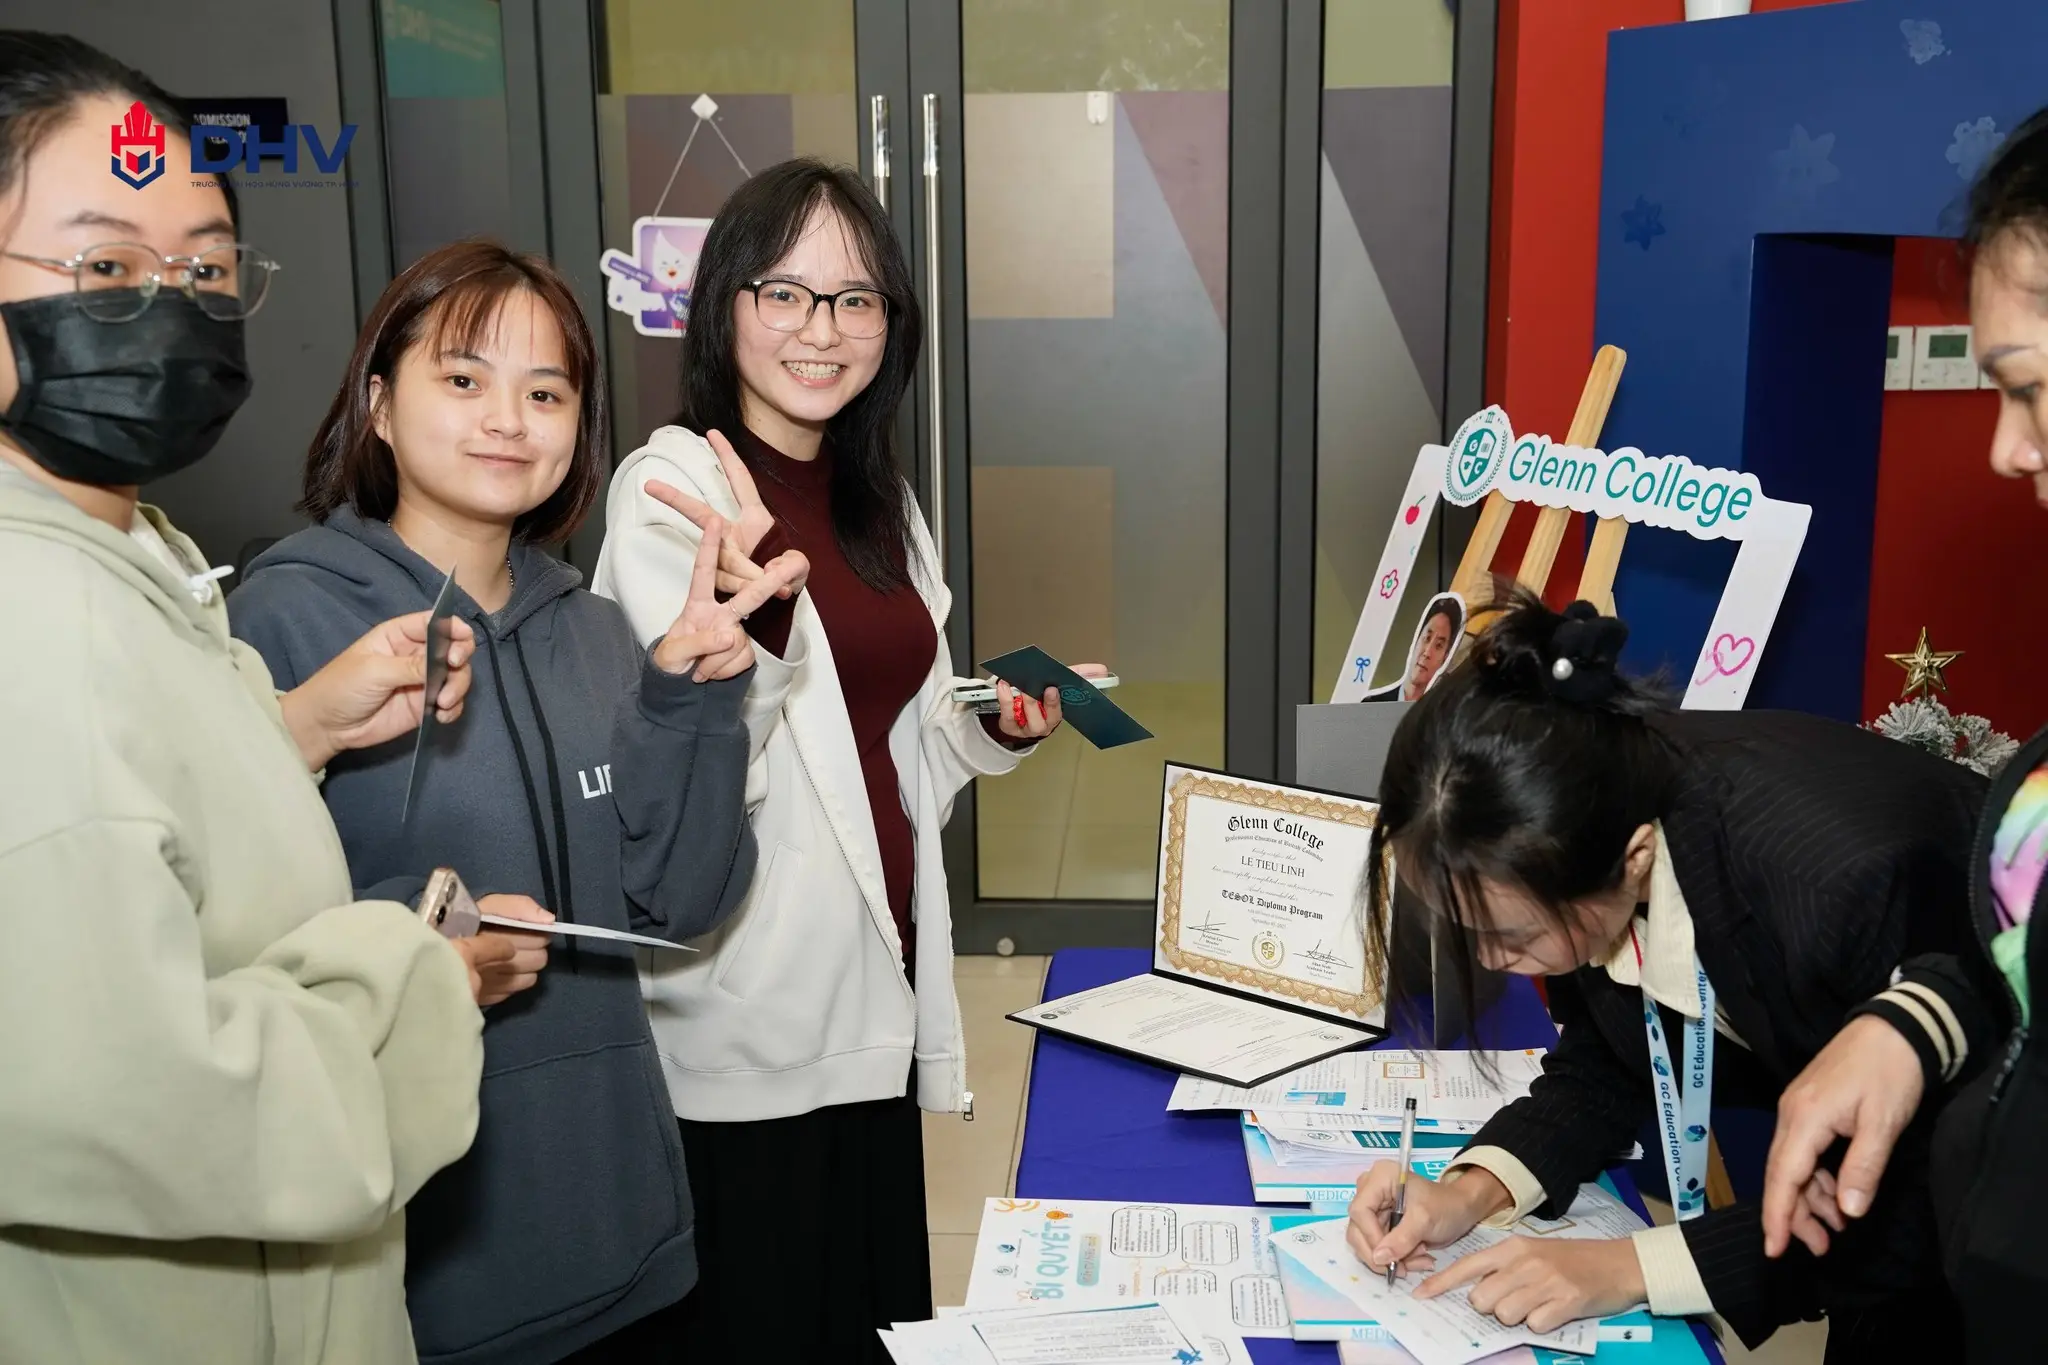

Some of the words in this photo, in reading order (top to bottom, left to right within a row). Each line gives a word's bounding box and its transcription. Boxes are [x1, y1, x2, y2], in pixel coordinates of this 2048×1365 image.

[1509, 442, 1597, 493] Glenn
[1605, 456, 1753, 528] College
[1227, 815, 1268, 831] Glenn
[1274, 817, 1324, 850] College
[1241, 856, 1254, 866] LE
[1256, 859, 1279, 872] TIEU
[1280, 864, 1305, 877] LINH
[1221, 889, 1255, 905] TESOL
[1257, 897, 1287, 912] Diploma
[1289, 905, 1324, 920] Program
[1660, 1081, 1671, 1100] GC
[1693, 1072, 1703, 1089] GC
[1663, 1101, 1681, 1164] Education
[1021, 1221, 1071, 1277] QUYẾT
